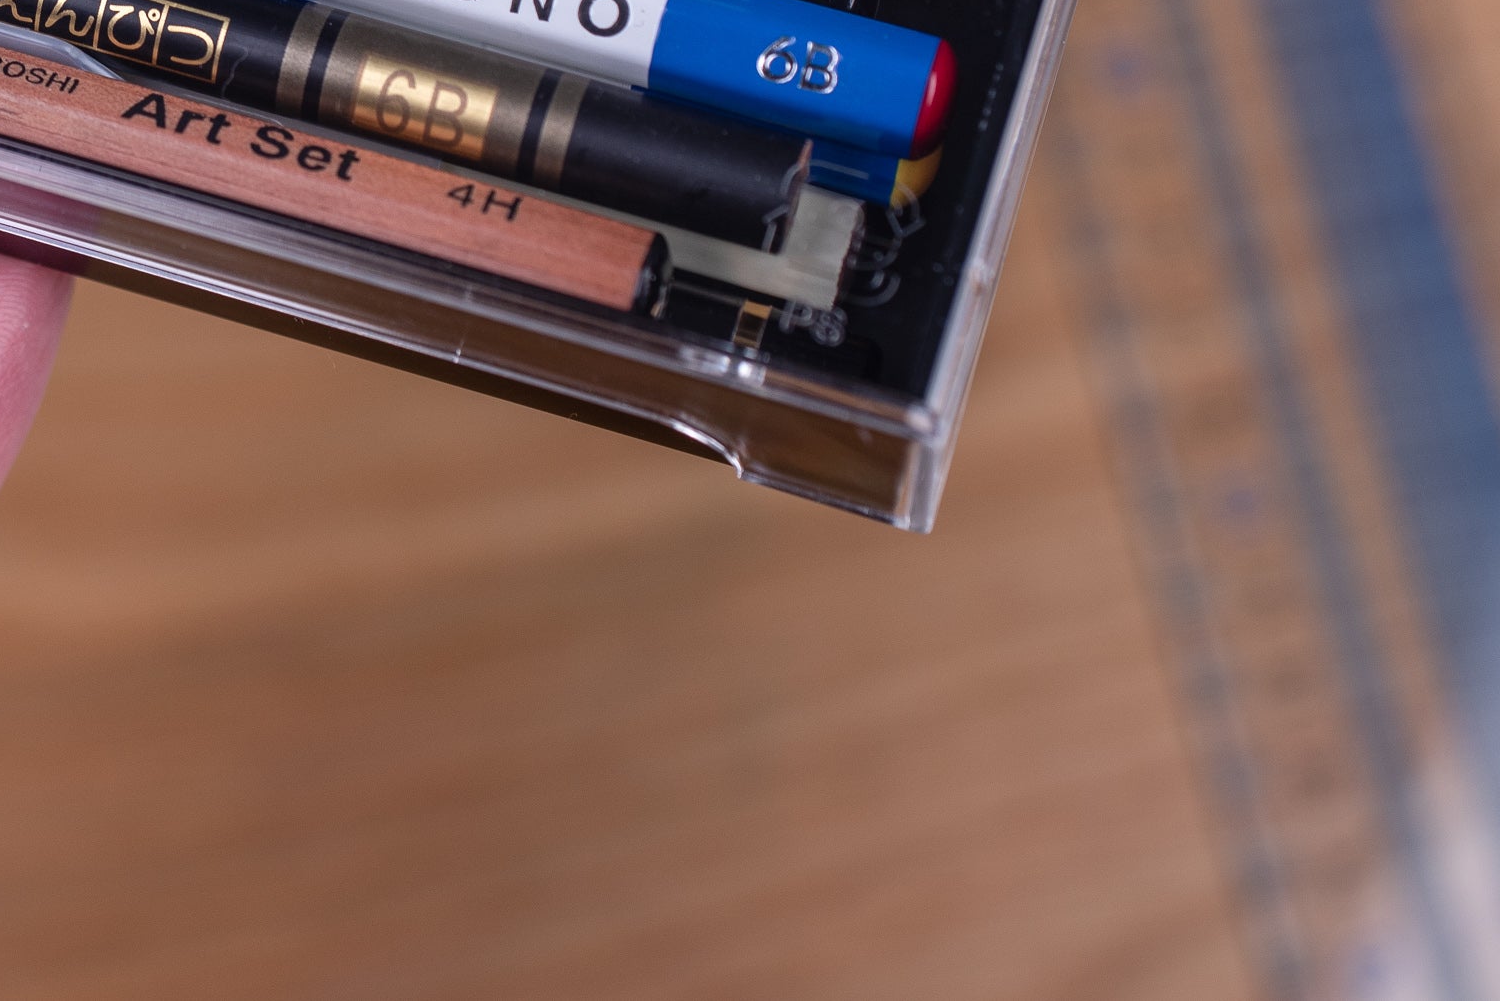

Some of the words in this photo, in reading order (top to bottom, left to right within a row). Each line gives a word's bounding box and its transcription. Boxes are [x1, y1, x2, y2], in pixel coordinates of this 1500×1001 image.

[755, 35, 842, 95] 6B
[120, 91, 228, 147] Art
[249, 120, 362, 182] Set
[376, 68, 470, 150] 6B
[447, 182, 524, 221] 4H
